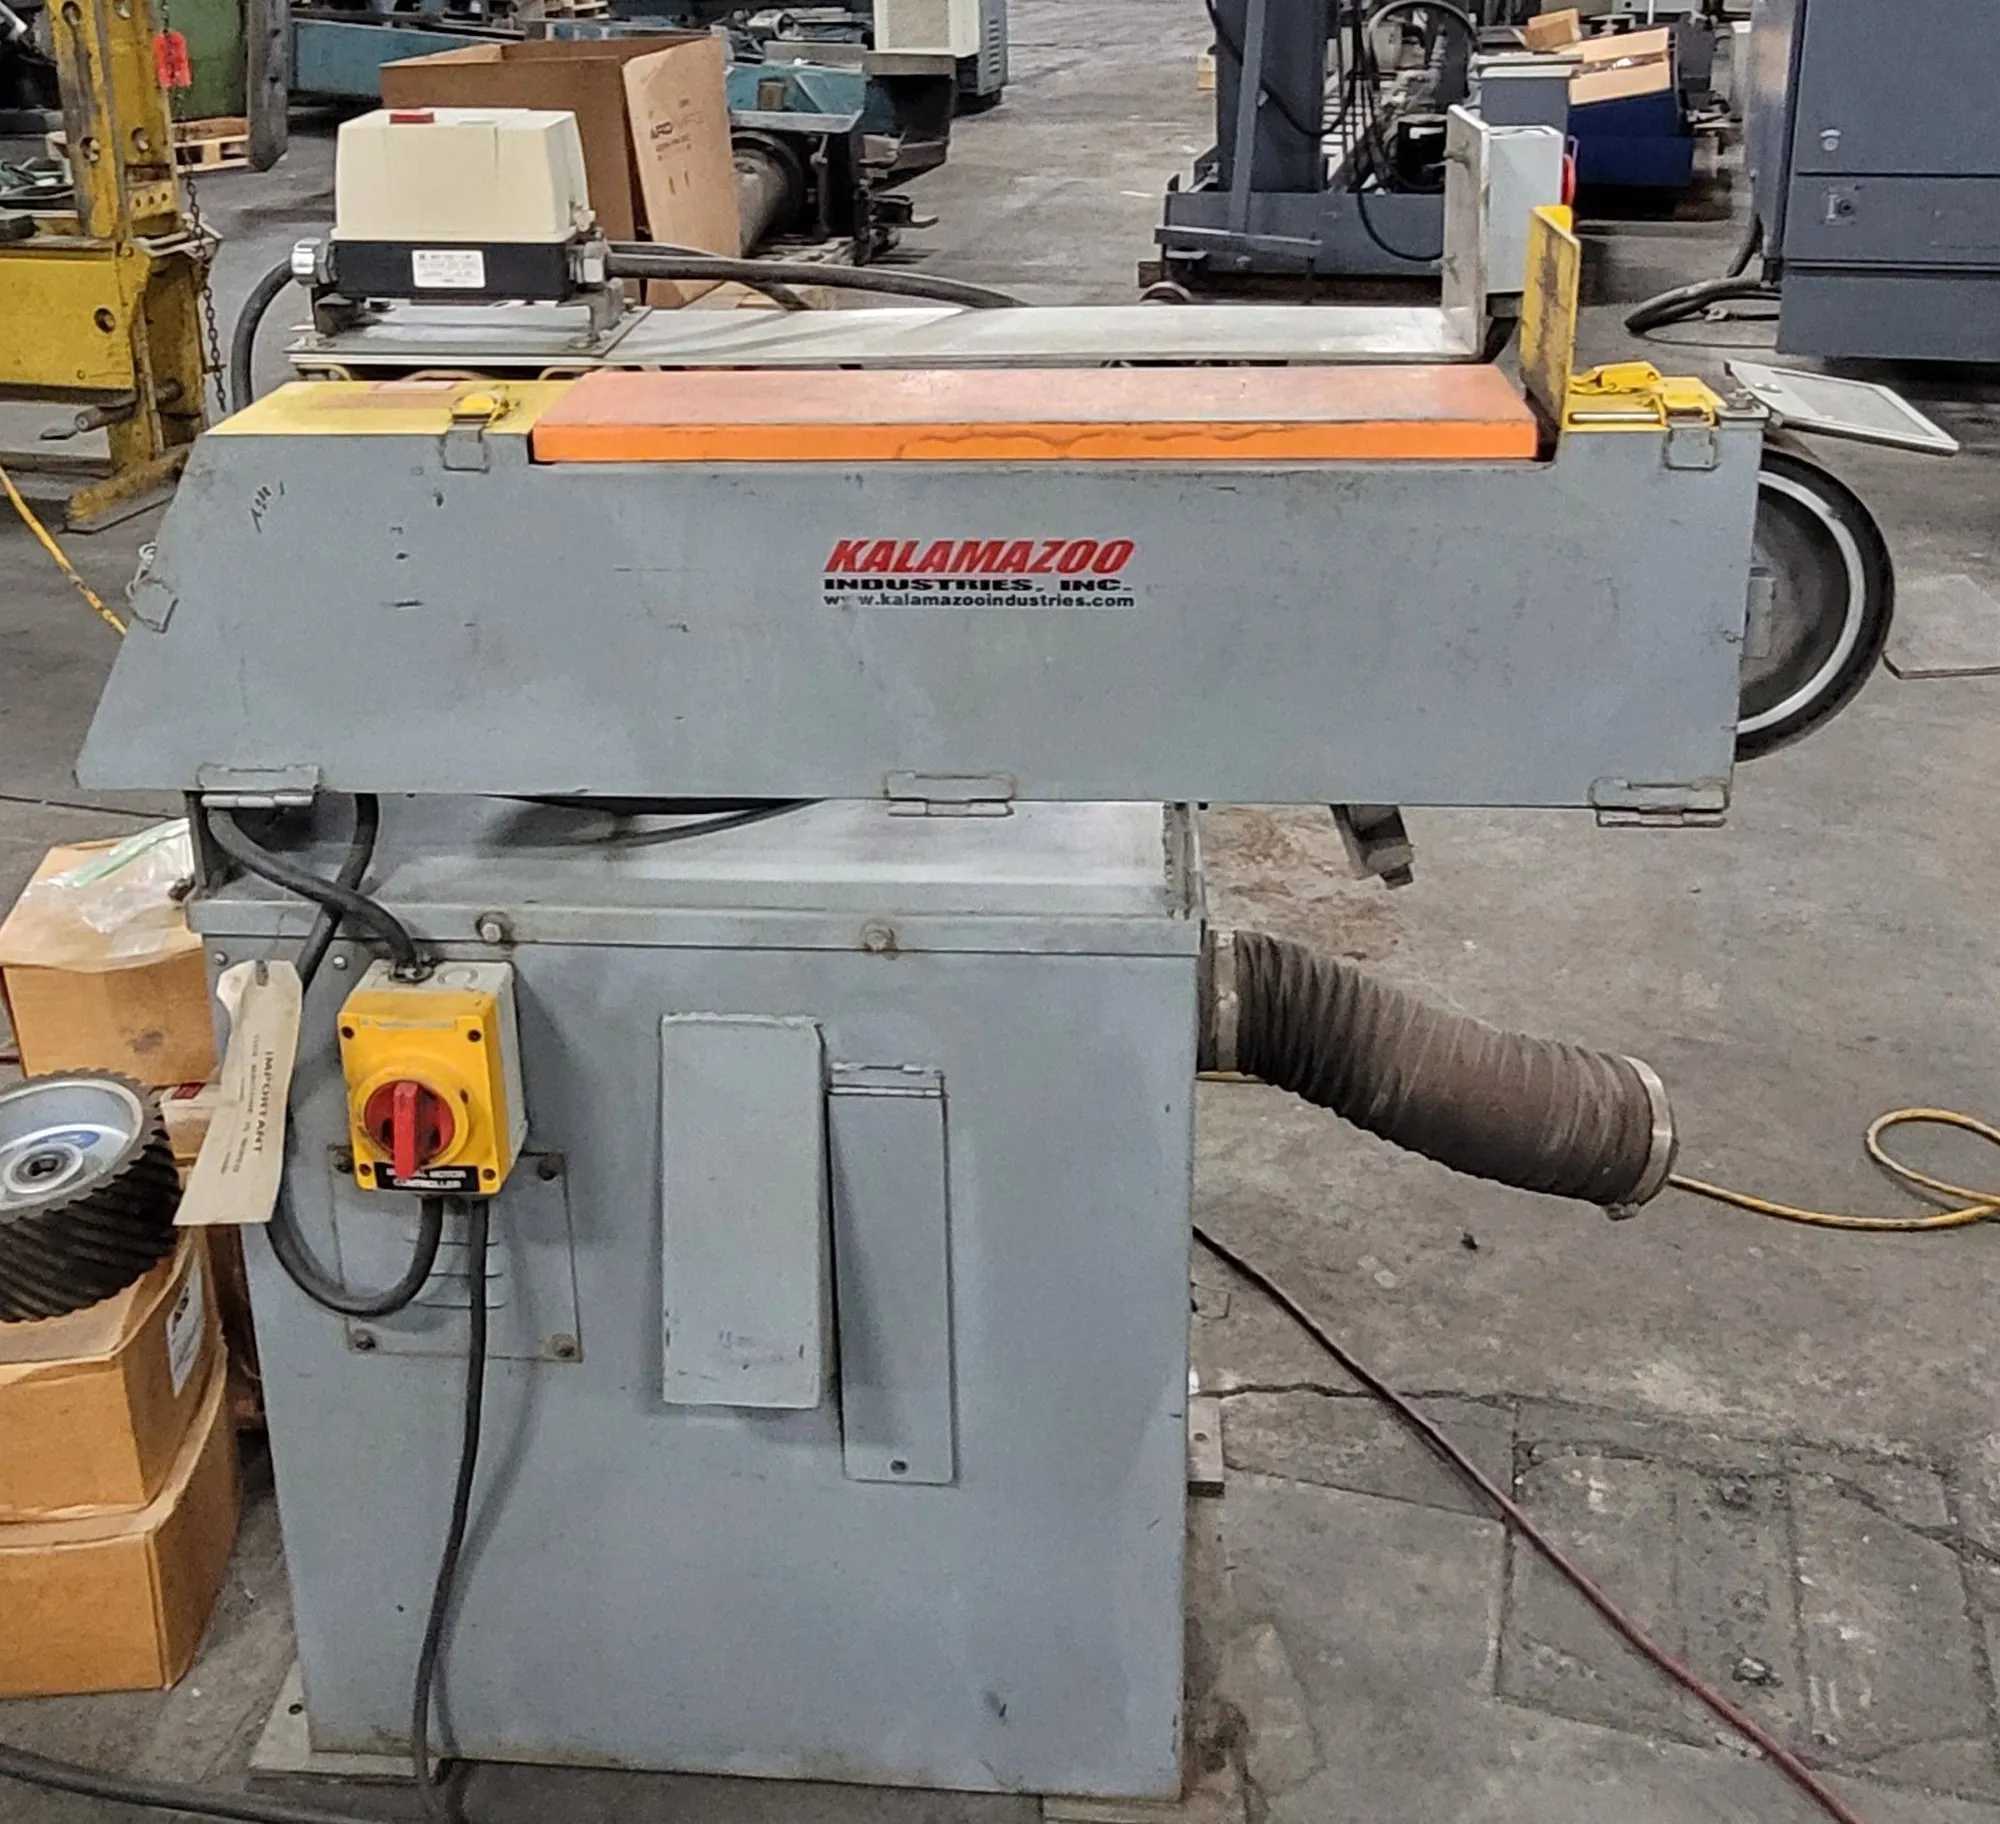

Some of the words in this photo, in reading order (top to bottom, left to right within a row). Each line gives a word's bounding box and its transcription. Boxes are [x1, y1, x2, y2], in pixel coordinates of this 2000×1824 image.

[824, 540, 1134, 573] KALAMAZOO
[1060, 579, 1133, 591] INC.
[253, 1051, 275, 1152] IMPORTANT
